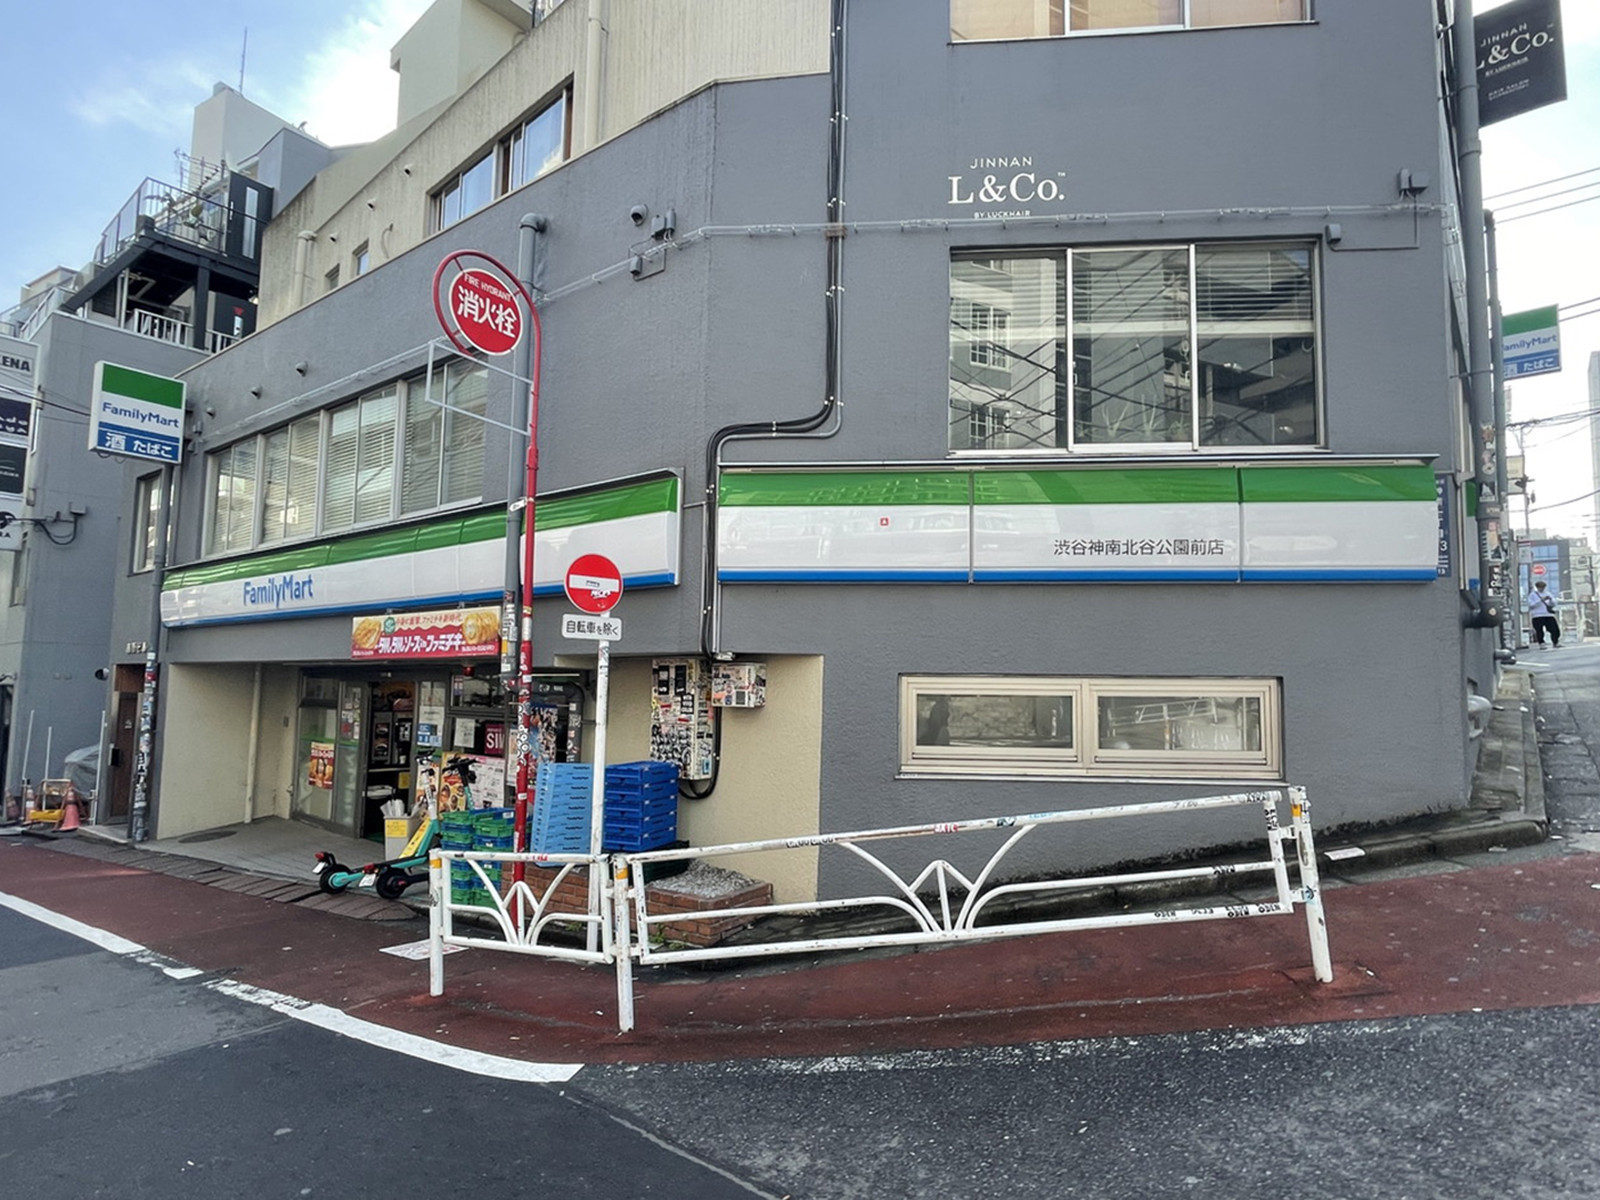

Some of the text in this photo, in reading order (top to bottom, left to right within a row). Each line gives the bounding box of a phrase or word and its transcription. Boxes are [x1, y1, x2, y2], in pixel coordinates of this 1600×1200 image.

[1481, 22, 1528, 47] JINNAN
[970, 156, 1033, 169] JINNAN
[464, 274, 512, 302] FIRE HYDRANT
[457, 285, 517, 338] 消火栓
[1523, 357, 1555, 372] たばこ
[102, 402, 180, 428] FamilyMart
[105, 432, 173, 458] 酒 たばこ
[1053, 539, 1224, 556] 渋谷神南北谷公園前店
[243, 574, 314, 609] FamilyMart
[566, 620, 619, 635] 自転車を除く
